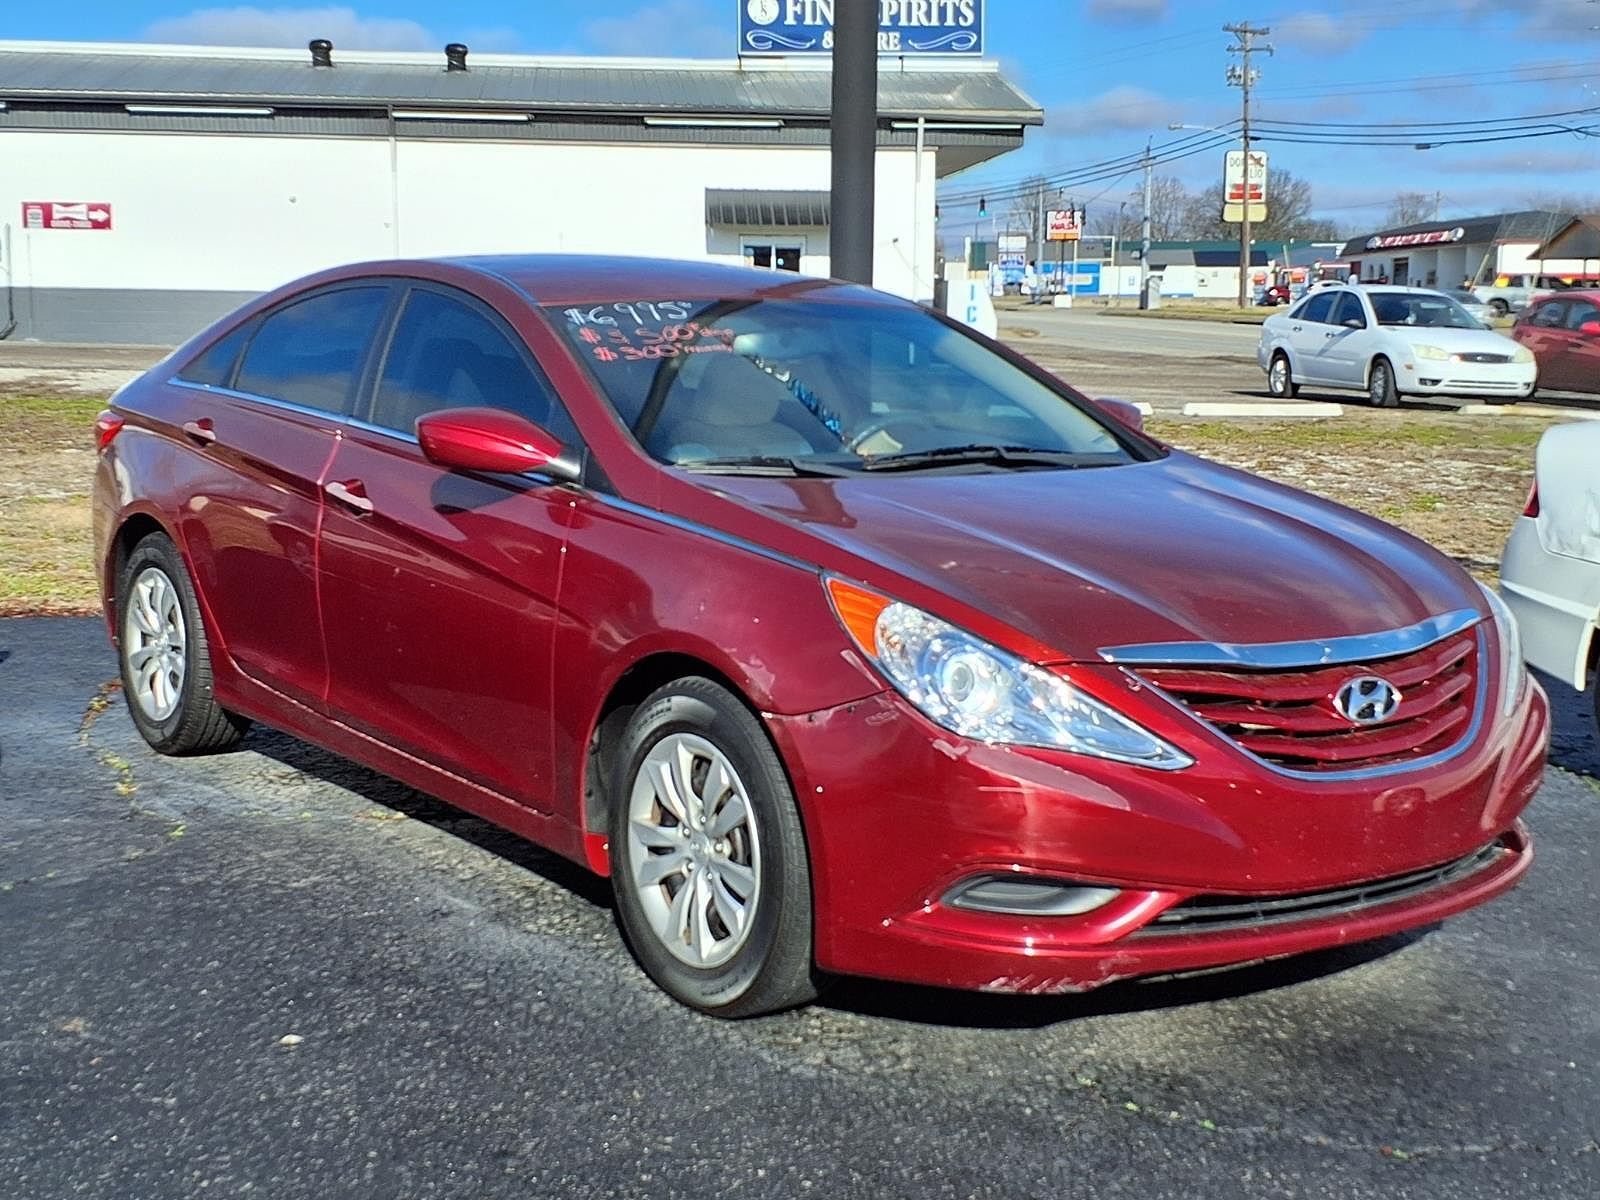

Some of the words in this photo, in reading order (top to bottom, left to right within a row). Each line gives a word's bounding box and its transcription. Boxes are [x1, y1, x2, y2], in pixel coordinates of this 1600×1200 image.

[784, 0, 834, 26] FIN
[878, 0, 975, 27] PIRITS
[877, 31, 901, 50] RE
[967, 284, 977, 322] IC
